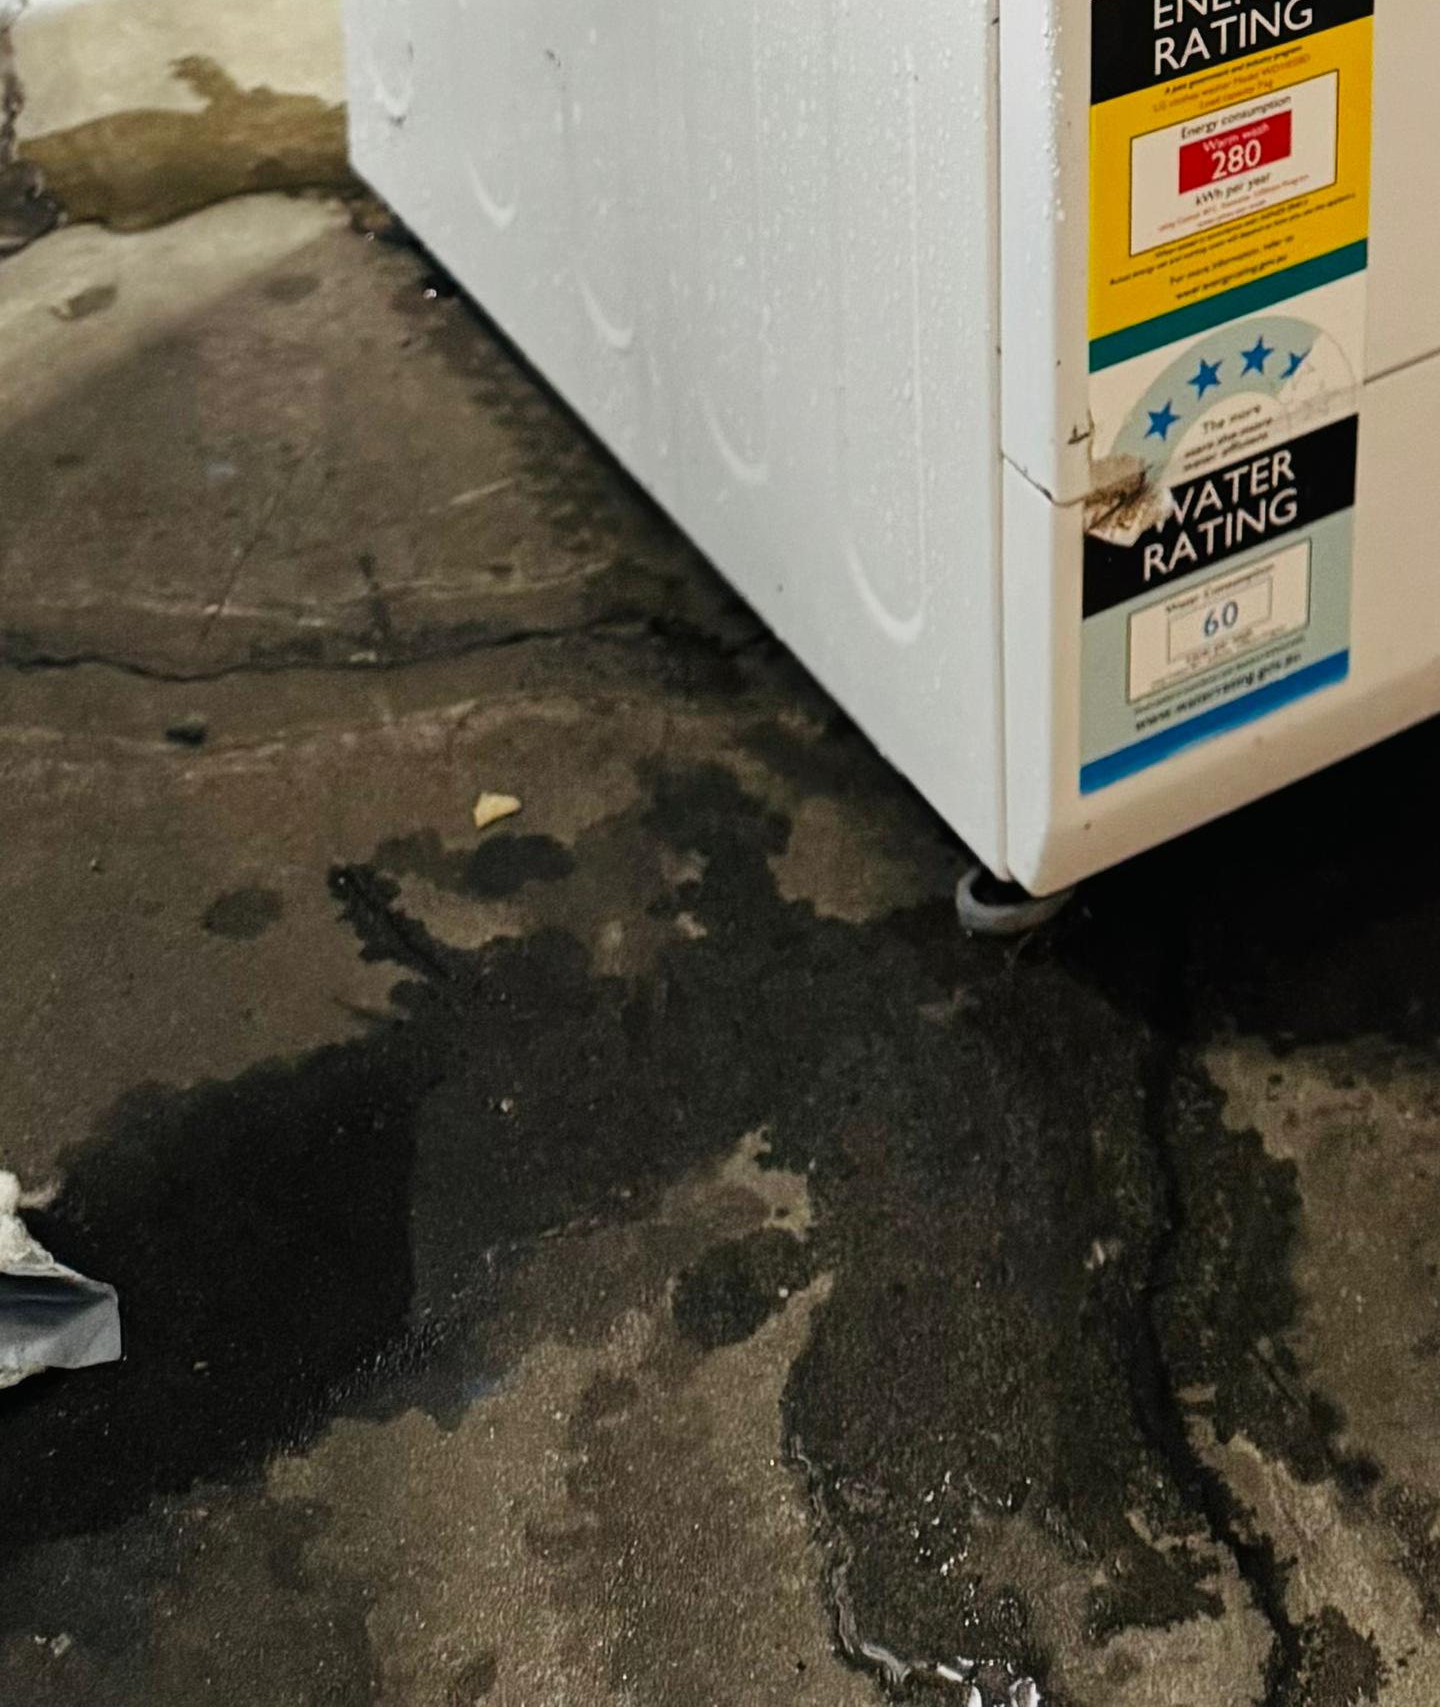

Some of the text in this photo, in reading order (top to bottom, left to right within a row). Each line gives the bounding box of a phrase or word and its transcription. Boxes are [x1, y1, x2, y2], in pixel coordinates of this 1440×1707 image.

[1181, 95, 1292, 141] Energy consumption
[1202, 122, 1271, 153] Warm wash
[1211, 139, 1263, 180] 280
[1195, 172, 1273, 206] kWh per year
[1143, 487, 1298, 582] RATING
[1204, 601, 1239, 637] 60
